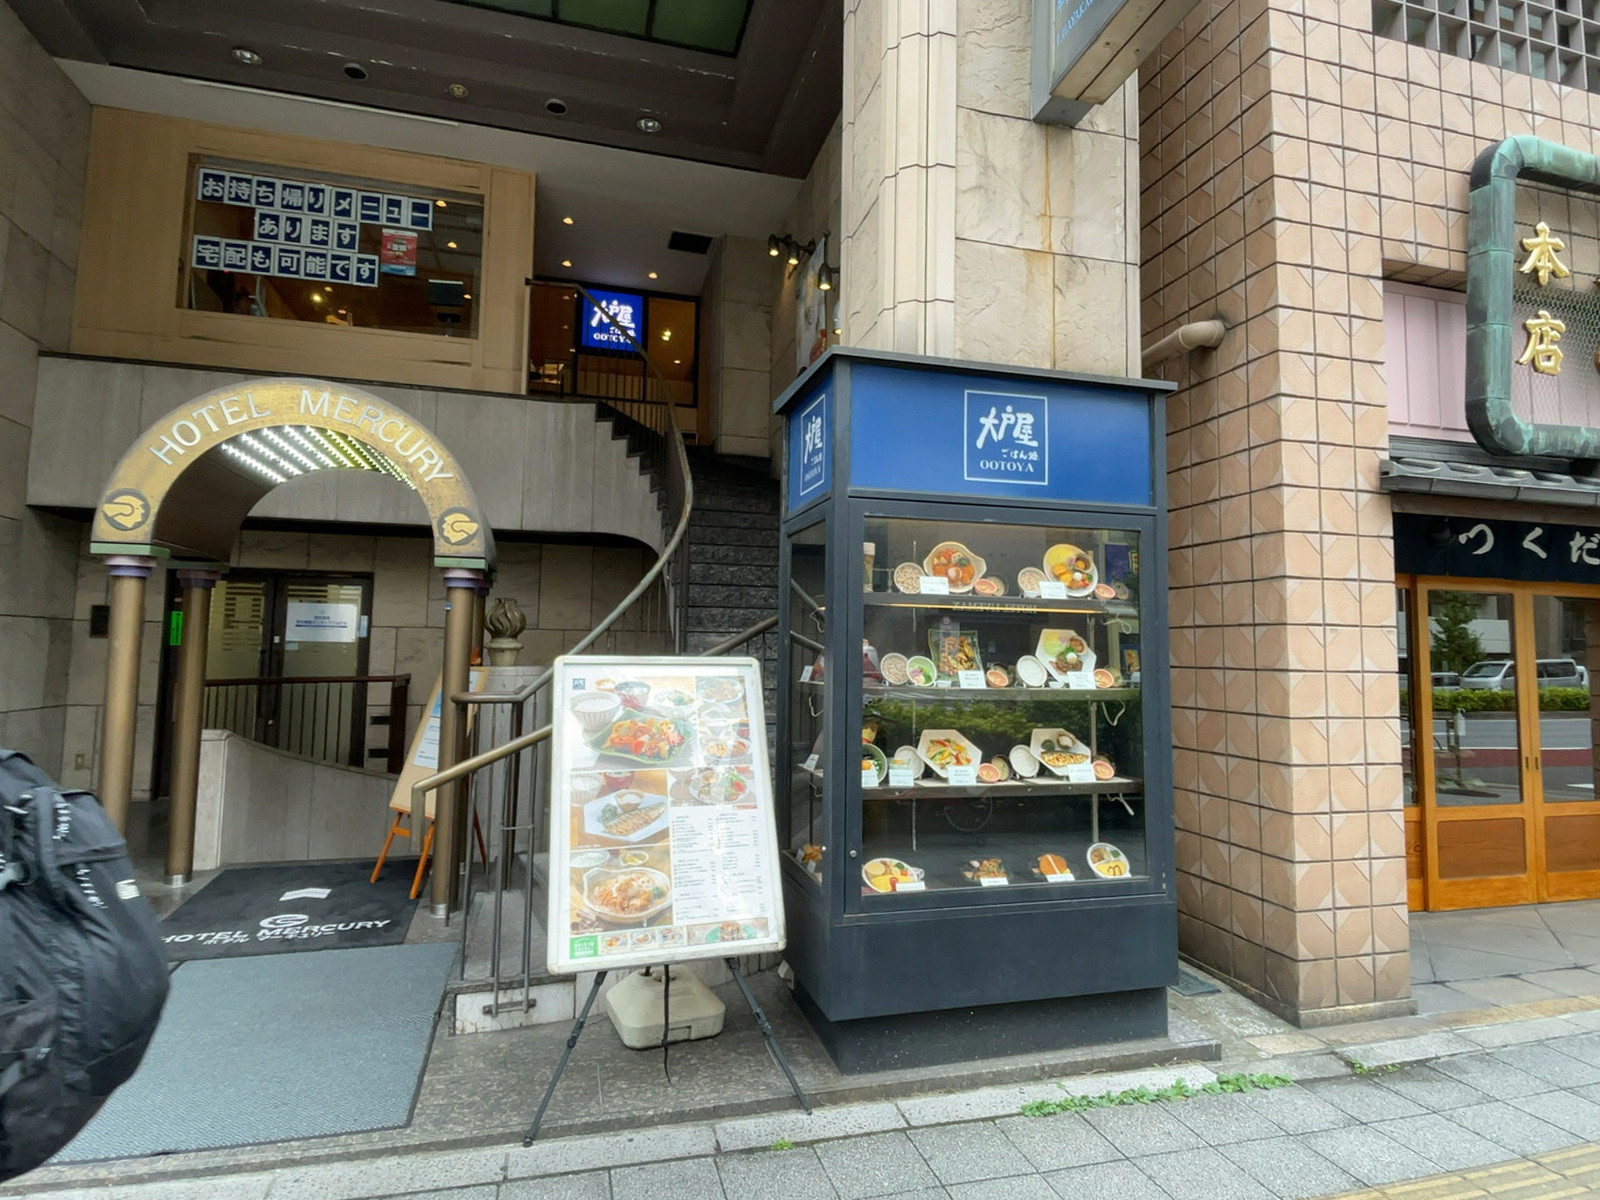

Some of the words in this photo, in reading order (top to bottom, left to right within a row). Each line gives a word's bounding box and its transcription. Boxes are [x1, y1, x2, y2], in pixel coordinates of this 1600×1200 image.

[202, 177, 430, 220] お持ち帰りメニュー
[259, 215, 357, 246] あります
[196, 241, 375, 281] 宅配も可能です
[1517, 221, 1570, 375] 本店
[149, 392, 270, 466] HOTEL
[299, 389, 455, 484] MERCURY
[976, 405, 1039, 449] 大戸屋
[979, 459, 1034, 473] OOTOYA
[1458, 523, 1600, 565] つくだ
[256, 918, 391, 937] MERCURY
